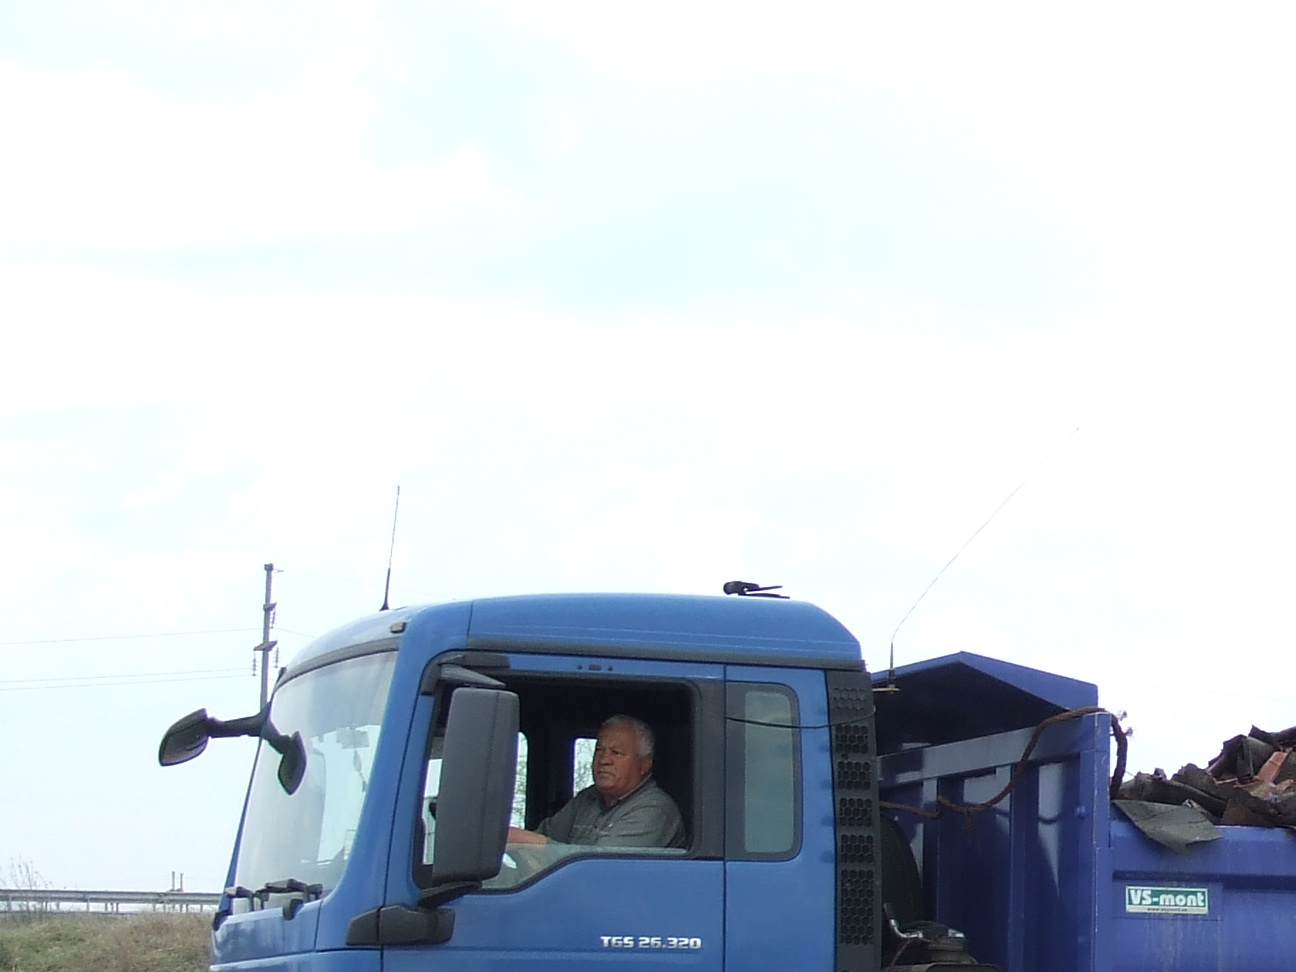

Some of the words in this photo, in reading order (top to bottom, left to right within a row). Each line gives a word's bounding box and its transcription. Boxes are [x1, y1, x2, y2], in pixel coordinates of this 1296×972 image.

[1129, 889, 1205, 907] VS-mont
[600, 935, 635, 949] TGS
[638, 936, 702, 950] 26.320
